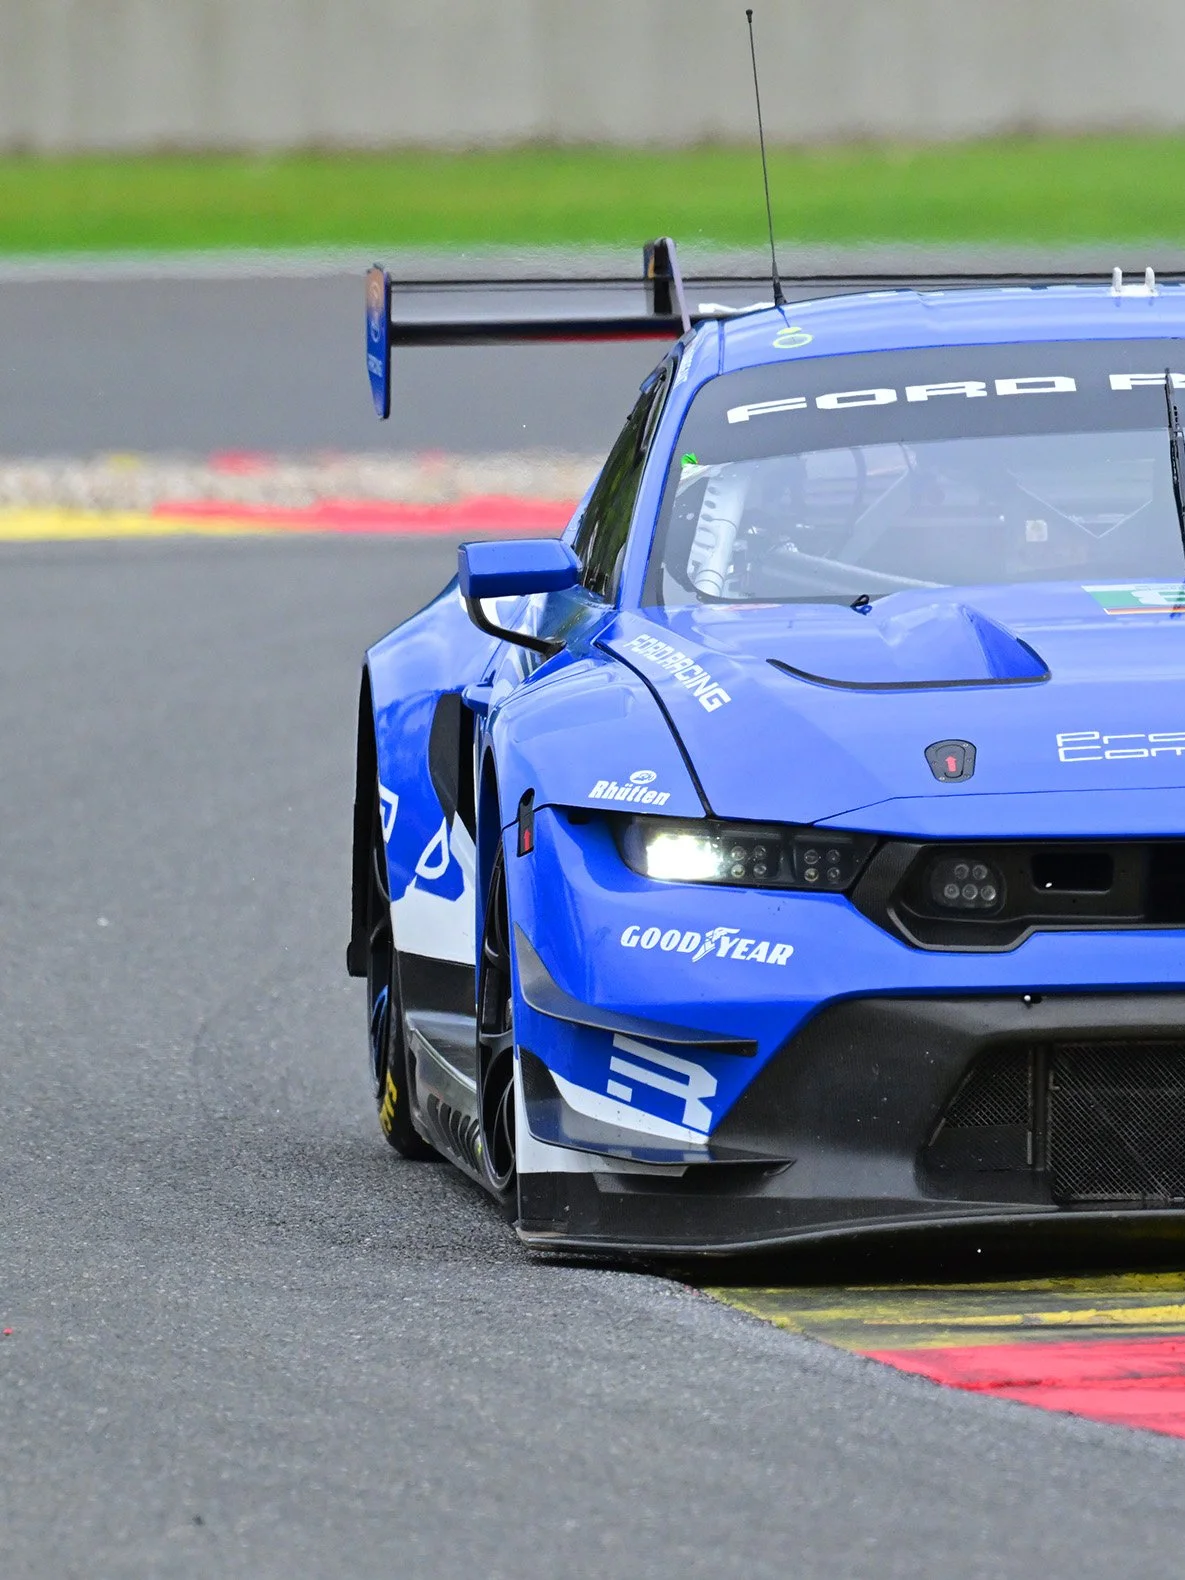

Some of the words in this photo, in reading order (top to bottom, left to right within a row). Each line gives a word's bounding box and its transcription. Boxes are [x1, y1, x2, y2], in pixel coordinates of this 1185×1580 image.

[726, 376, 1077, 424] FORD
[623, 634, 675, 664] FORD
[662, 651, 732, 713] RACING
[588, 780, 671, 806] Rhütten
